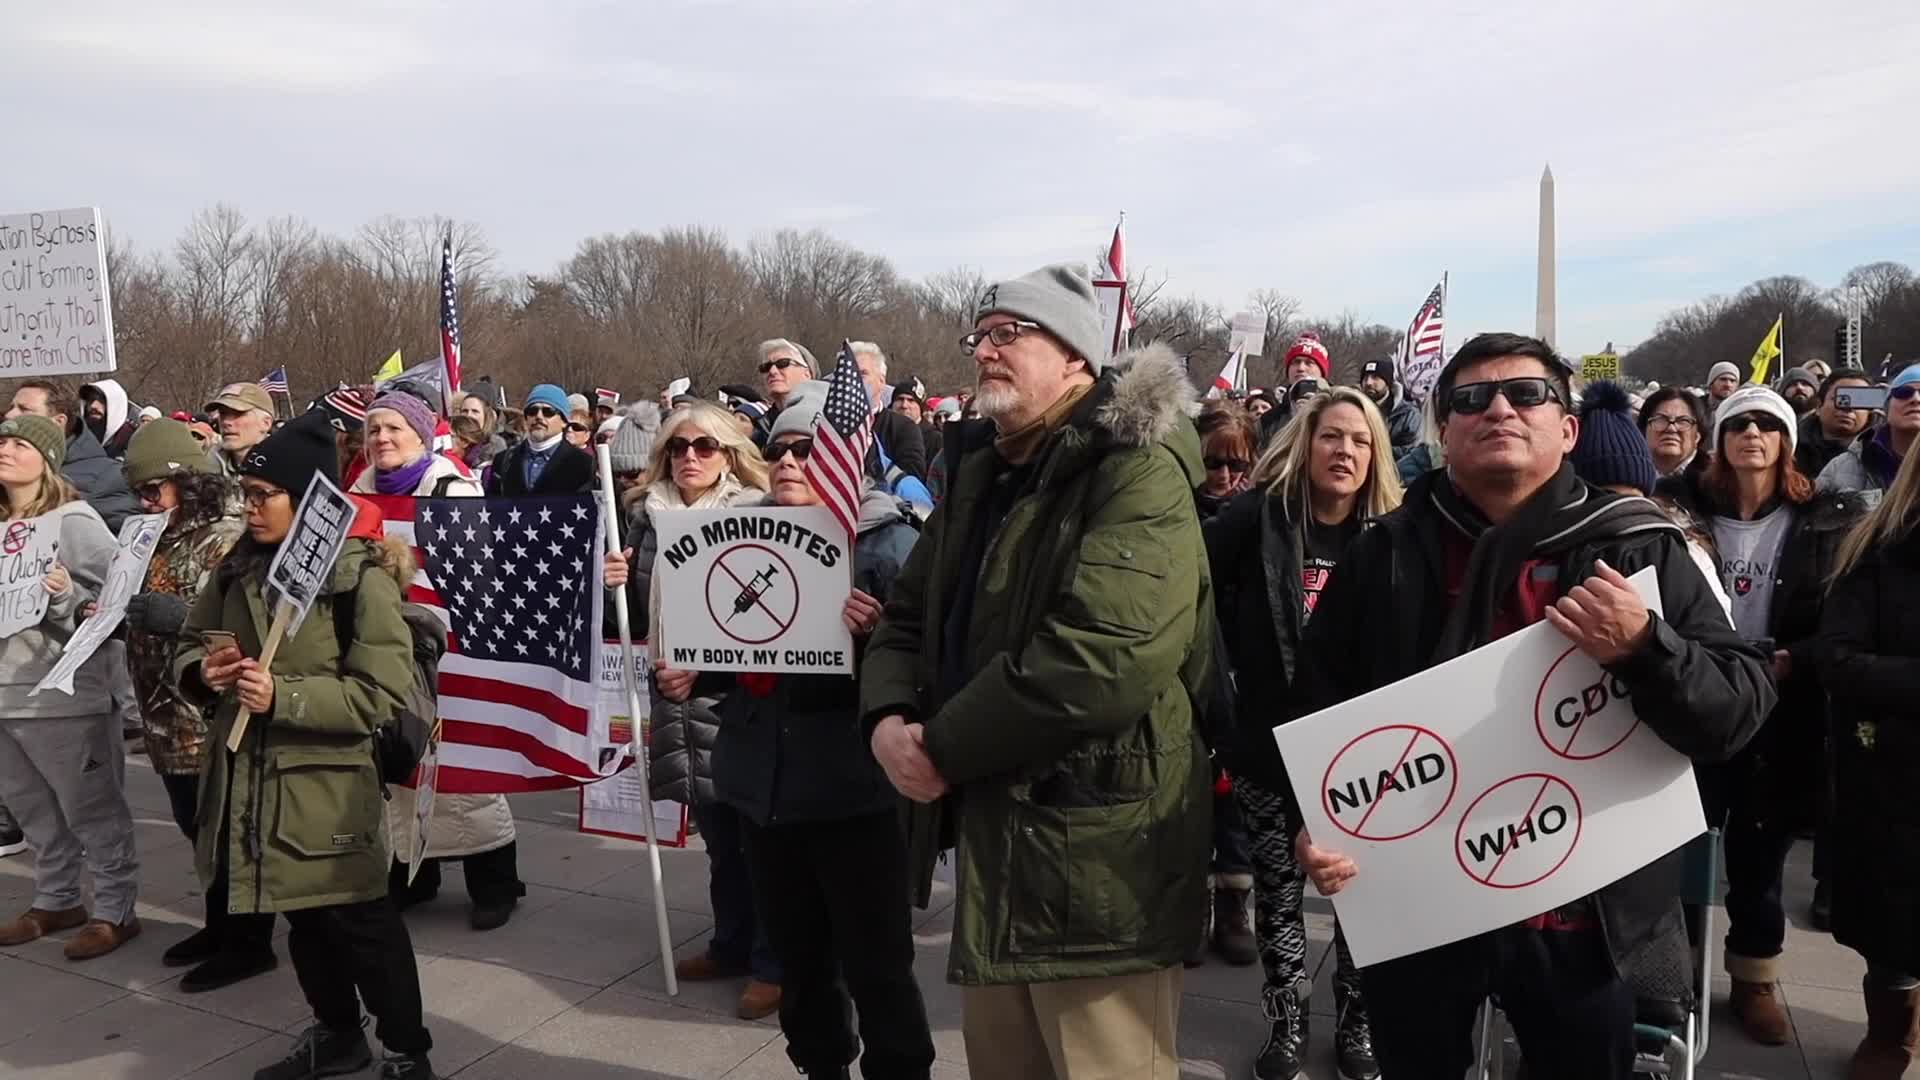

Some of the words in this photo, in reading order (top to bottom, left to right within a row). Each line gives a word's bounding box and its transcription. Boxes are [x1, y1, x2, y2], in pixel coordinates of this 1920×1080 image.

[0, 222, 27, 249] tion
[31, 212, 97, 253] Psychosis
[65, 293, 103, 328] that
[34, 335, 63, 367] from
[1583, 358, 1616, 367] JESUS
[1583, 368, 1616, 379] SAVES
[304, 506, 338, 546] DATES
[664, 534, 698, 569] NO
[701, 517, 841, 567] MANDATES
[1723, 559, 1774, 579] RGINIA
[674, 648, 697, 663] MY
[703, 649, 748, 666] BODY,
[754, 651, 778, 665] MY
[785, 651, 844, 666] CHOICE
[1555, 675, 1632, 728] CDC
[1328, 752, 1446, 814] NIAID
[1465, 804, 1567, 862] WHO
